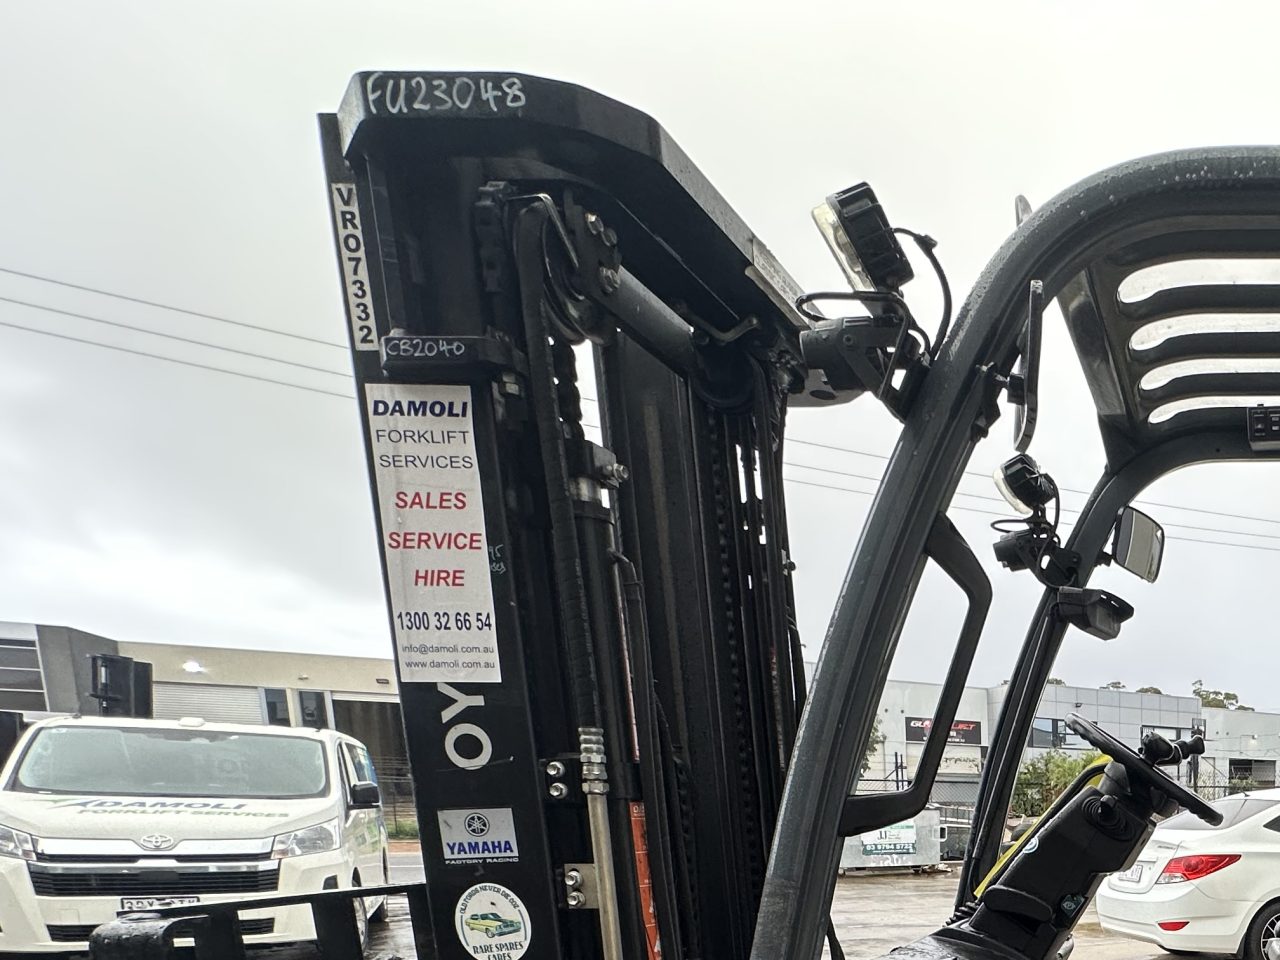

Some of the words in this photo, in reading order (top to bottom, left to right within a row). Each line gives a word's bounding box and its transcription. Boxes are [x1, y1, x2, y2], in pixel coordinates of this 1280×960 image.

[366, 72, 526, 114] FU23048
[372, 399, 469, 418] DAMOLI
[375, 429, 469, 445] FORKLIFT
[379, 455, 474, 470] SERVICES
[395, 491, 467, 510] SALES
[387, 532, 483, 551] SERVICE
[414, 569, 466, 588] HIRE
[397, 611, 430, 631] 1300
[434, 612, 452, 631] 32
[455, 612, 472, 631] 66
[476, 612, 493, 631] 54
[402, 644, 495, 655] info@damoli.com.au
[405, 660, 496, 669] www.damoli.com.au
[93, 800, 247, 810] DAMOLI
[446, 840, 514, 855] YAMAHA
[480, 885, 501, 893] NEVER
[472, 945, 494, 954] RARE
[494, 941, 524, 952] SPARES
